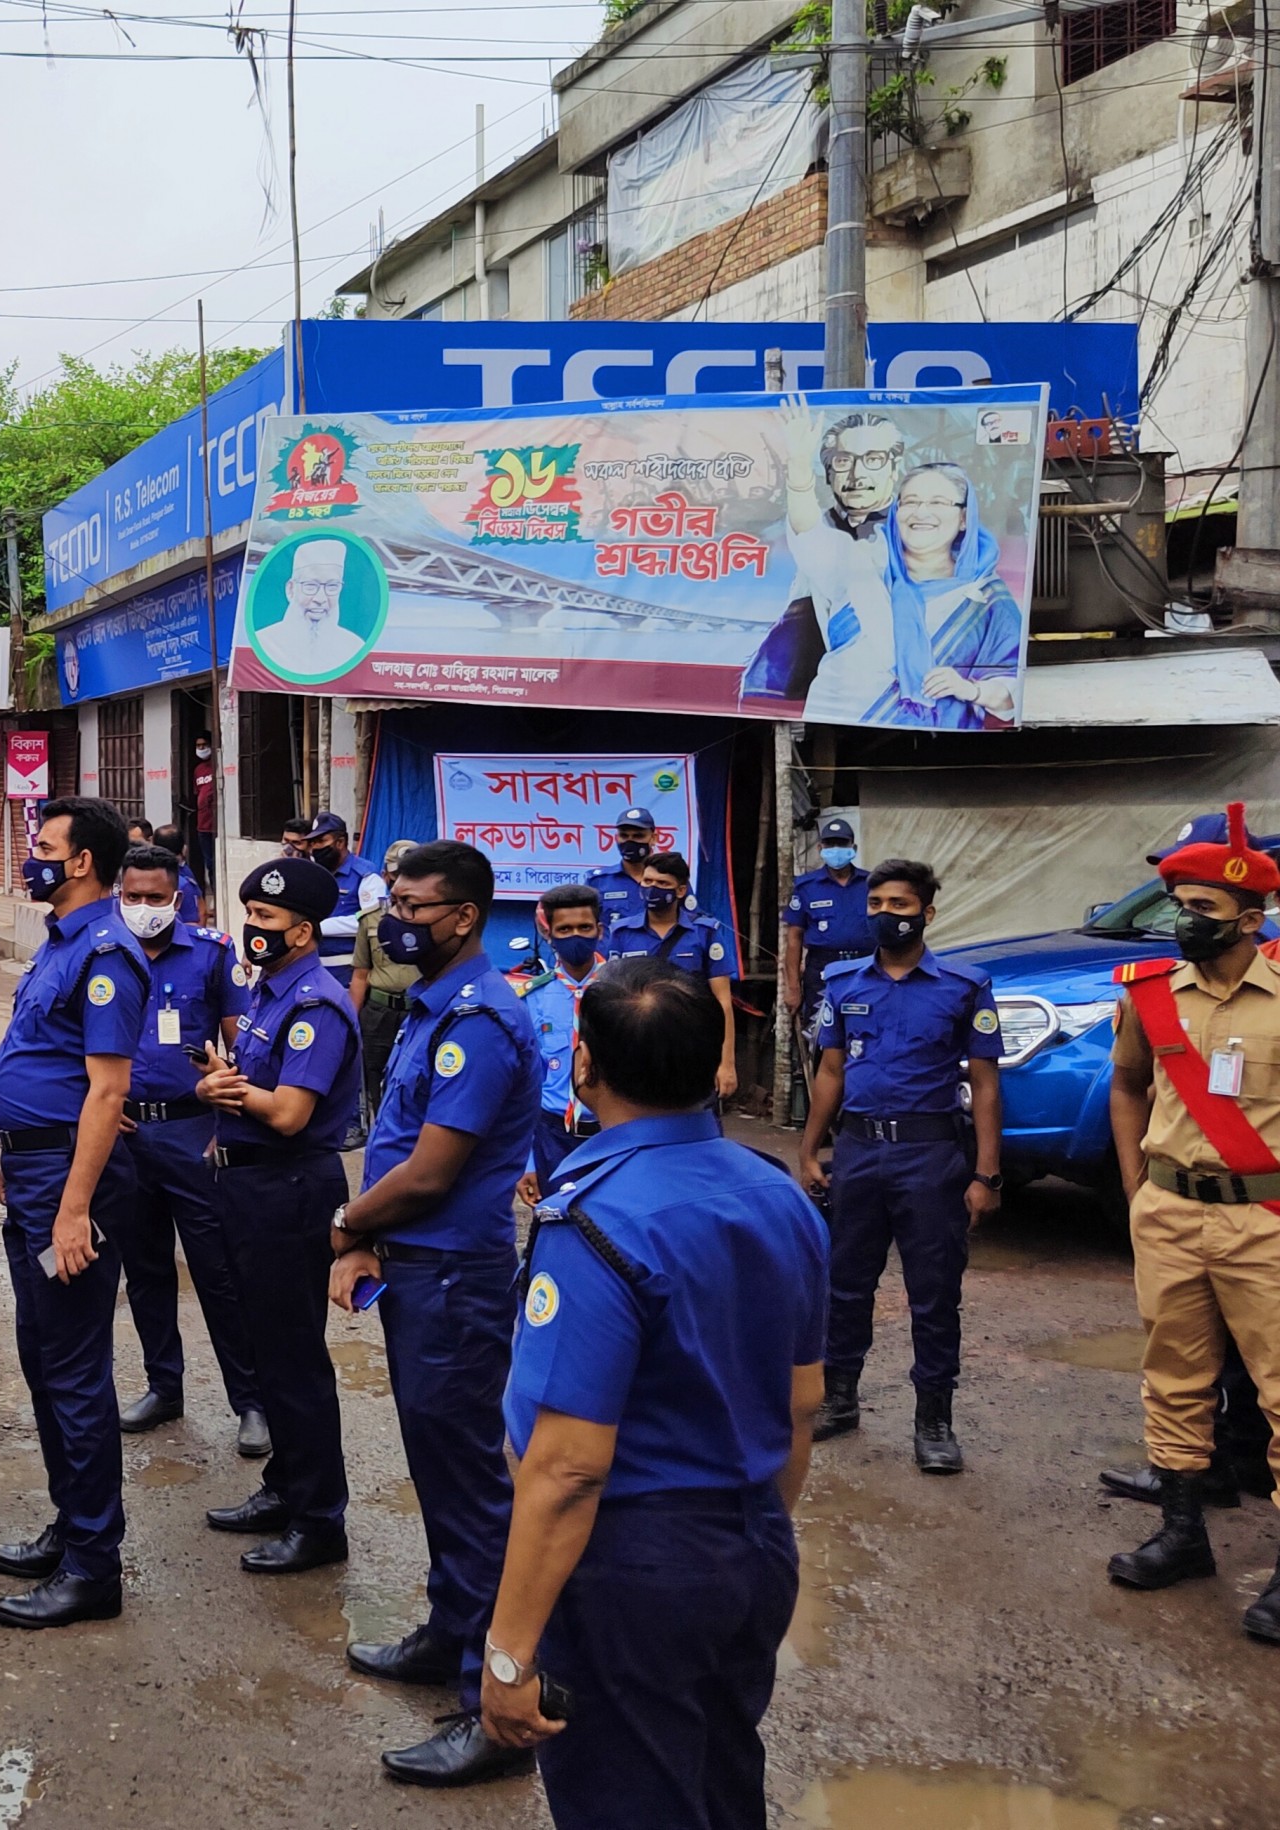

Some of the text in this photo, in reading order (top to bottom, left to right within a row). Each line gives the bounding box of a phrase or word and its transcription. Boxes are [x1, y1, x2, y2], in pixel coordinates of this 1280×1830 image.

[198, 396, 284, 497] TEC
[491, 450, 556, 508] ১৬
[584, 453, 754, 481] সকল শহীদদের প্রতি
[114, 464, 179, 524] R.S. Telecom
[291, 488, 340, 505] বিজয়ের
[521, 500, 569, 517] ডিসেম্বর
[307, 505, 332, 518] বছর
[478, 508, 568, 540] বিজয় দিবস
[610, 491, 718, 537] গভীর
[49, 513, 101, 588] TECNO
[595, 532, 769, 581] শ্রদ্ধাঞ্জলি
[371, 660, 560, 684] আলহাজ্ব মোঃ হাবিবুর রহমান মালেক
[11, 735, 45, 750] বিকাশ
[15, 753, 40, 763] করুন
[483, 769, 637, 806] সাবধান
[453, 812, 585, 855] লকডাউন
